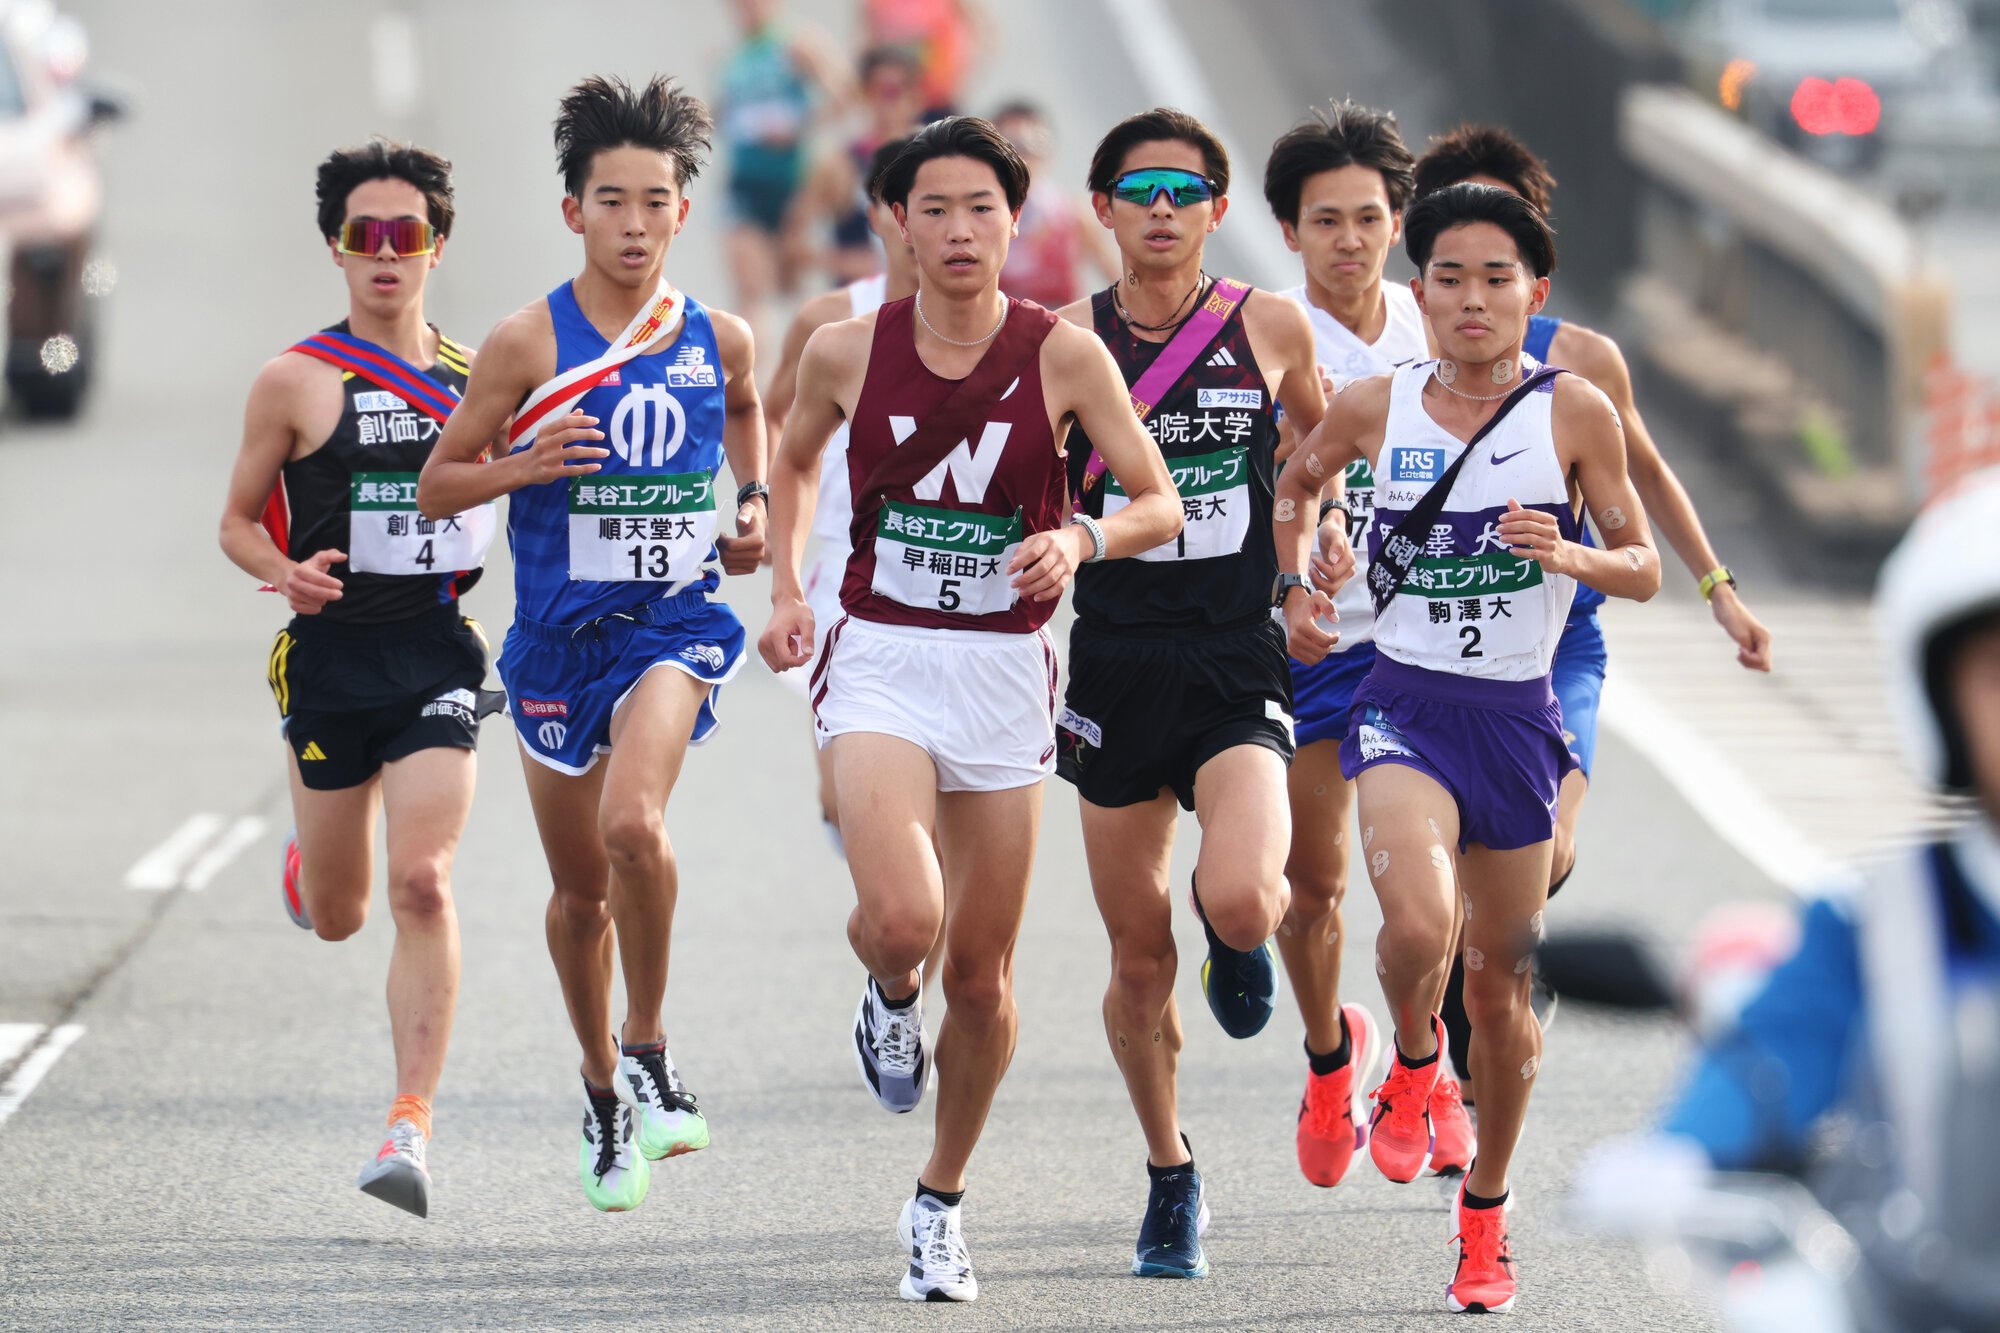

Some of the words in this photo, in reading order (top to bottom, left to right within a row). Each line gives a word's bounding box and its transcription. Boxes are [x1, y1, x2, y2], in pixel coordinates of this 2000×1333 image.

[669, 367, 715, 386] EXEO
[1217, 391, 1260, 405] アサガミ
[1400, 451, 1434, 470] HRS
[598, 516, 695, 540] 順天堂大
[884, 510, 1012, 546] 長谷工グルー
[415, 539, 435, 571] 4
[628, 545, 669, 578] 13
[902, 547, 1001, 579] 早稲田大
[938, 579, 961, 611] 5
[1428, 596, 1512, 624] 駒澤大
[1459, 626, 1483, 658] 2
